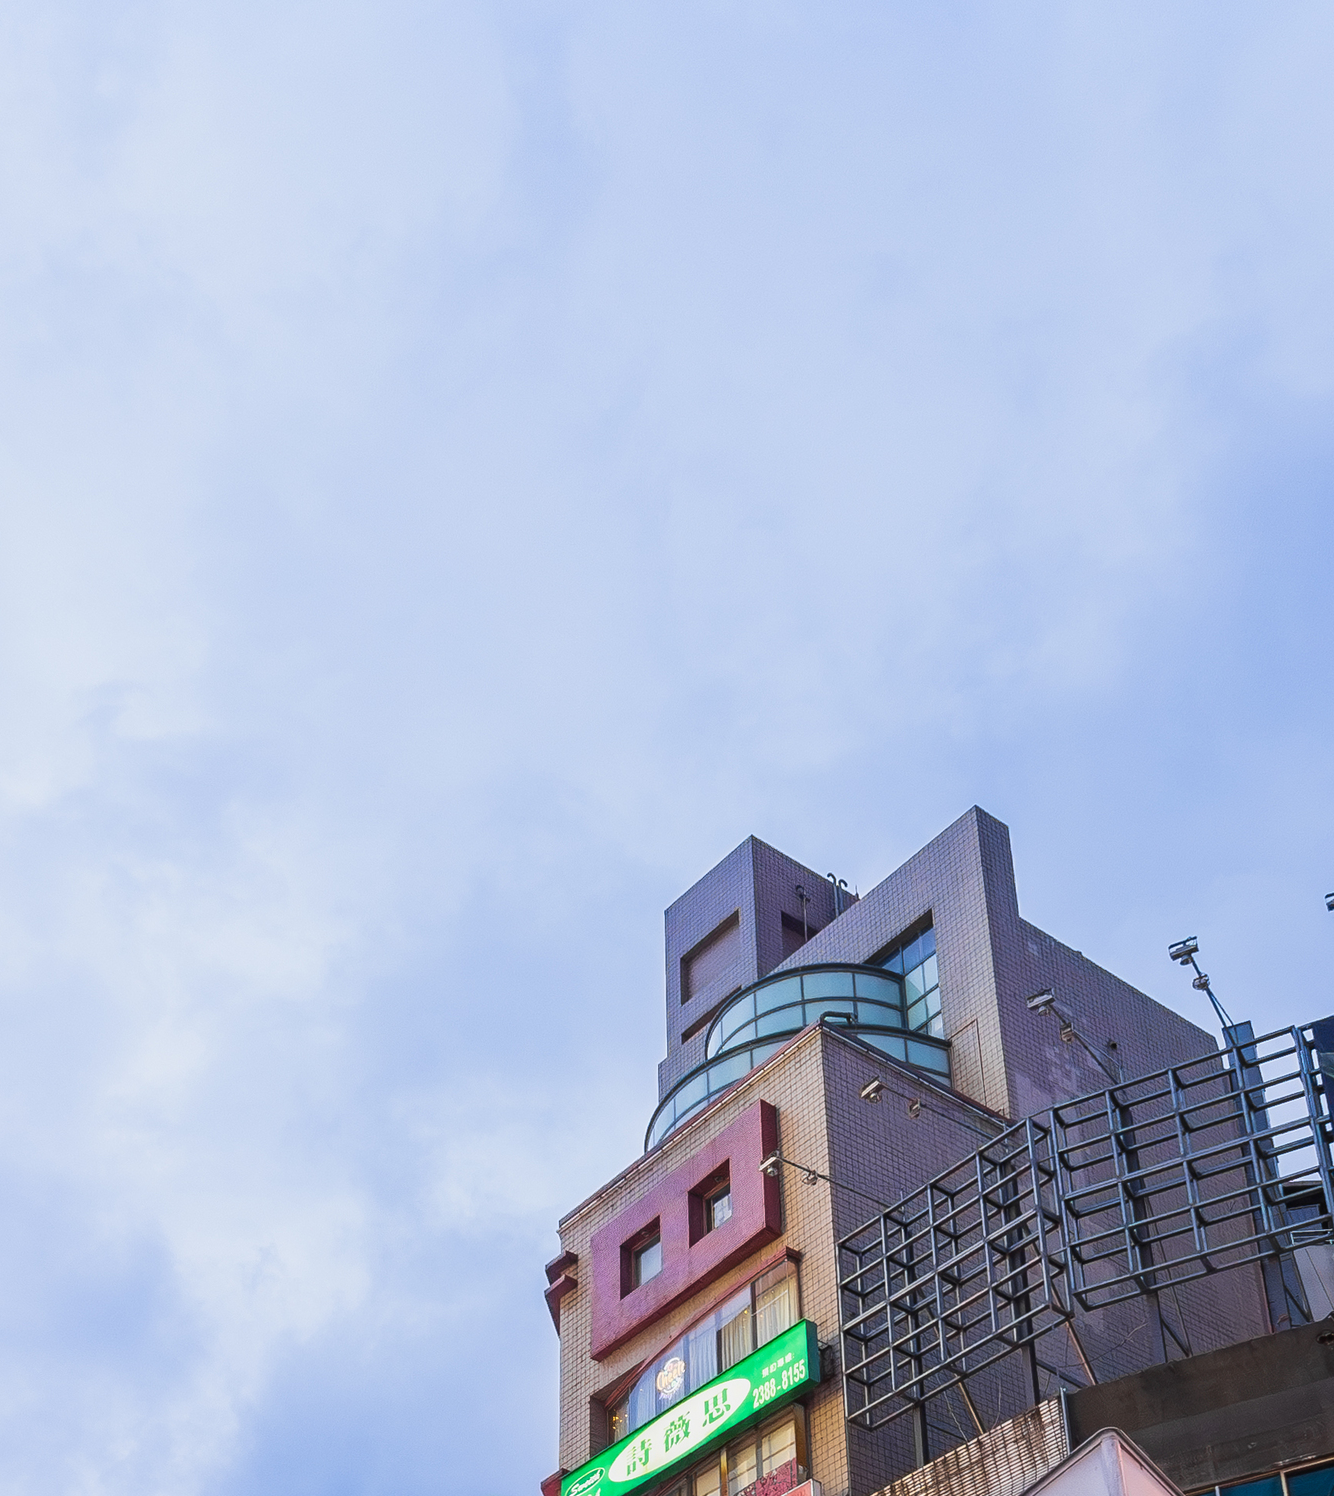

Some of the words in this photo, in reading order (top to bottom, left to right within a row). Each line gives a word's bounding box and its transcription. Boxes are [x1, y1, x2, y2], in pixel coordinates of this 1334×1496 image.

[753, 1358, 807, 1409] 2388-8155
[627, 1388, 732, 1477] 詩薇思
